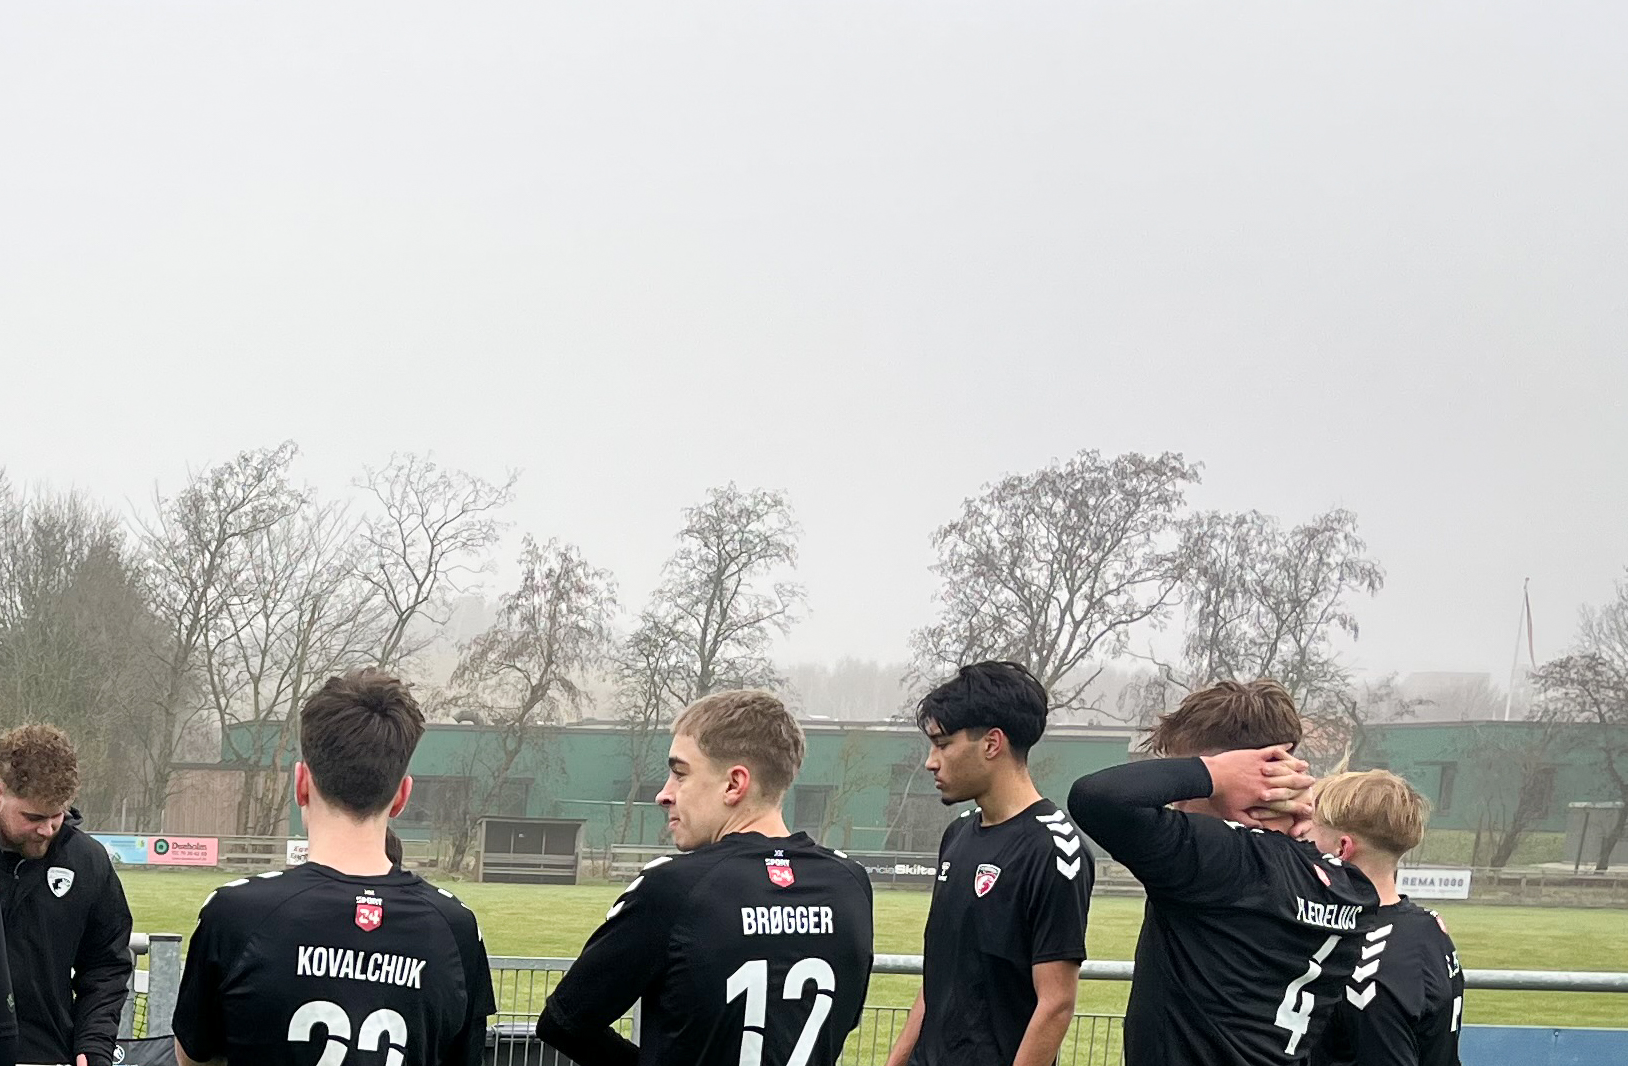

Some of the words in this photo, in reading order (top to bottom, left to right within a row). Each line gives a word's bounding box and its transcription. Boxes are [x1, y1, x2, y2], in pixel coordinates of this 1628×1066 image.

[1402, 877, 1435, 887] REMA
[1438, 877, 1464, 887] 1000
[358, 908, 381, 924] 24
[741, 906, 833, 935] BRØGGER
[297, 945, 426, 989] KOVALCHUK
[1274, 934, 1342, 1055] 4
